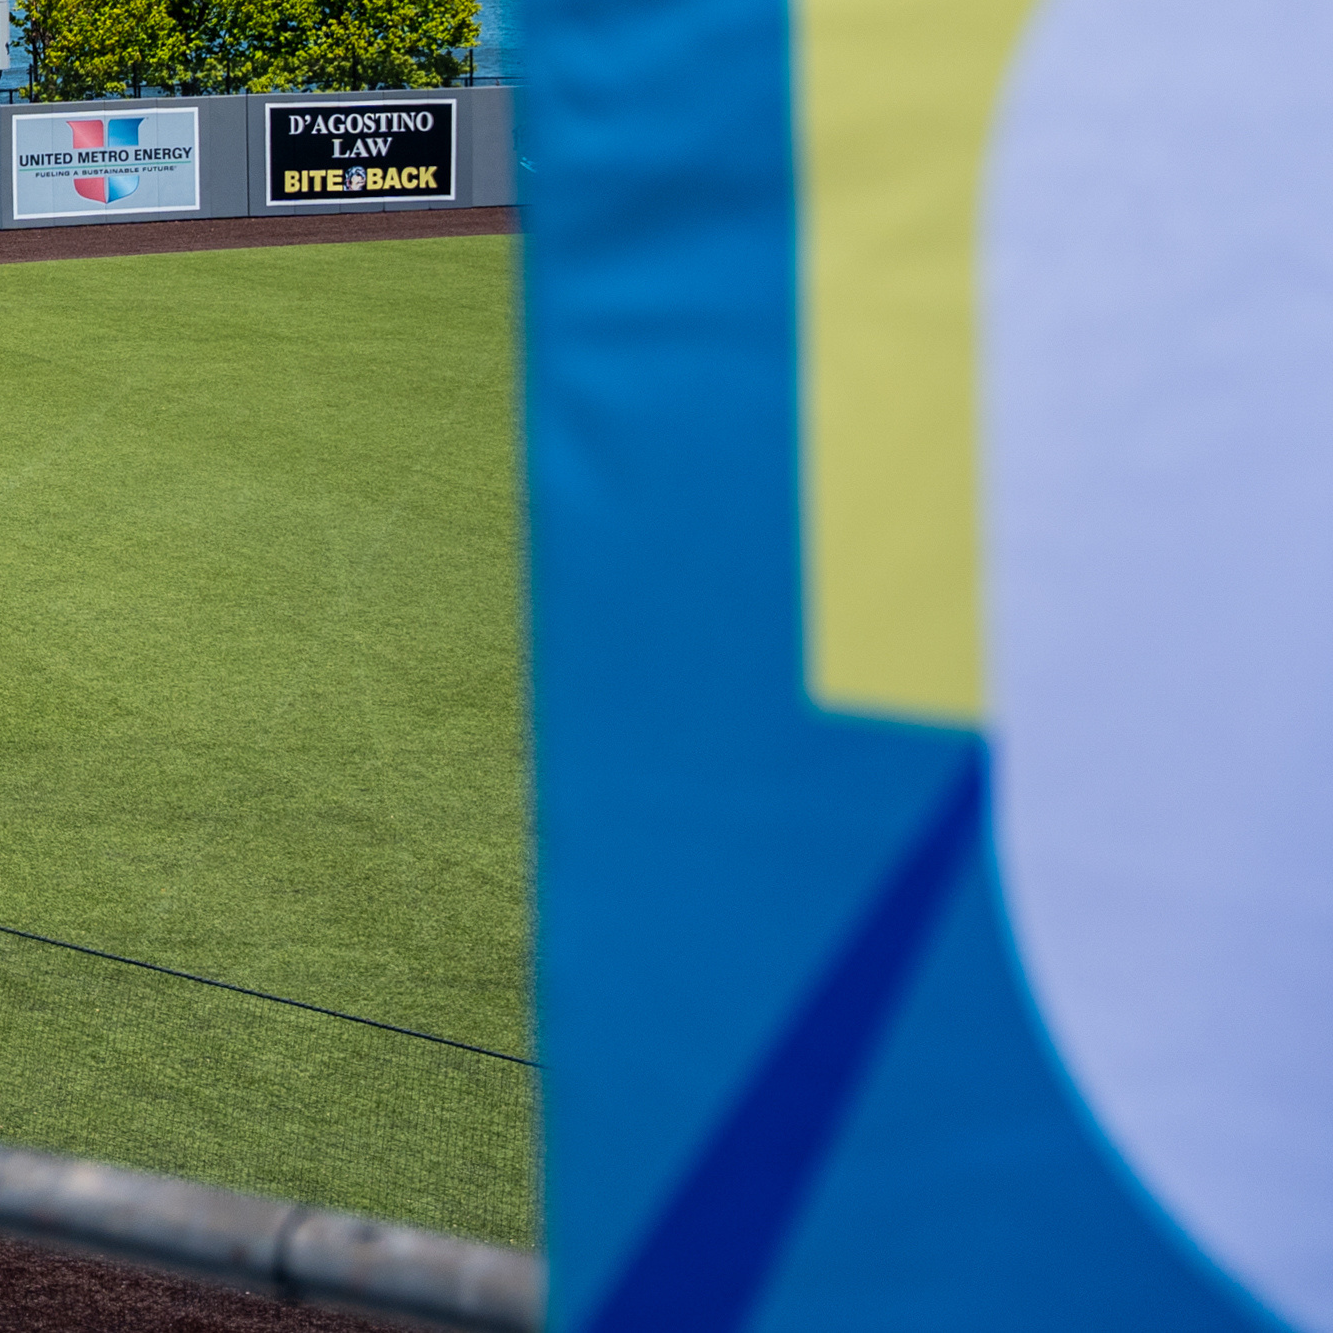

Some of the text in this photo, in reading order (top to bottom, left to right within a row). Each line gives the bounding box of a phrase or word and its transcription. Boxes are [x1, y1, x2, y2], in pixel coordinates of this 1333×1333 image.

[288, 111, 434, 135] D'AGOSTINO
[19, 147, 192, 167] UNITED METRO ENERGY
[331, 137, 393, 158] LAW
[35, 170, 70, 178] FUELING
[82, 167, 139, 175] SUSTAINABLE
[284, 166, 438, 193] BITE BACK
